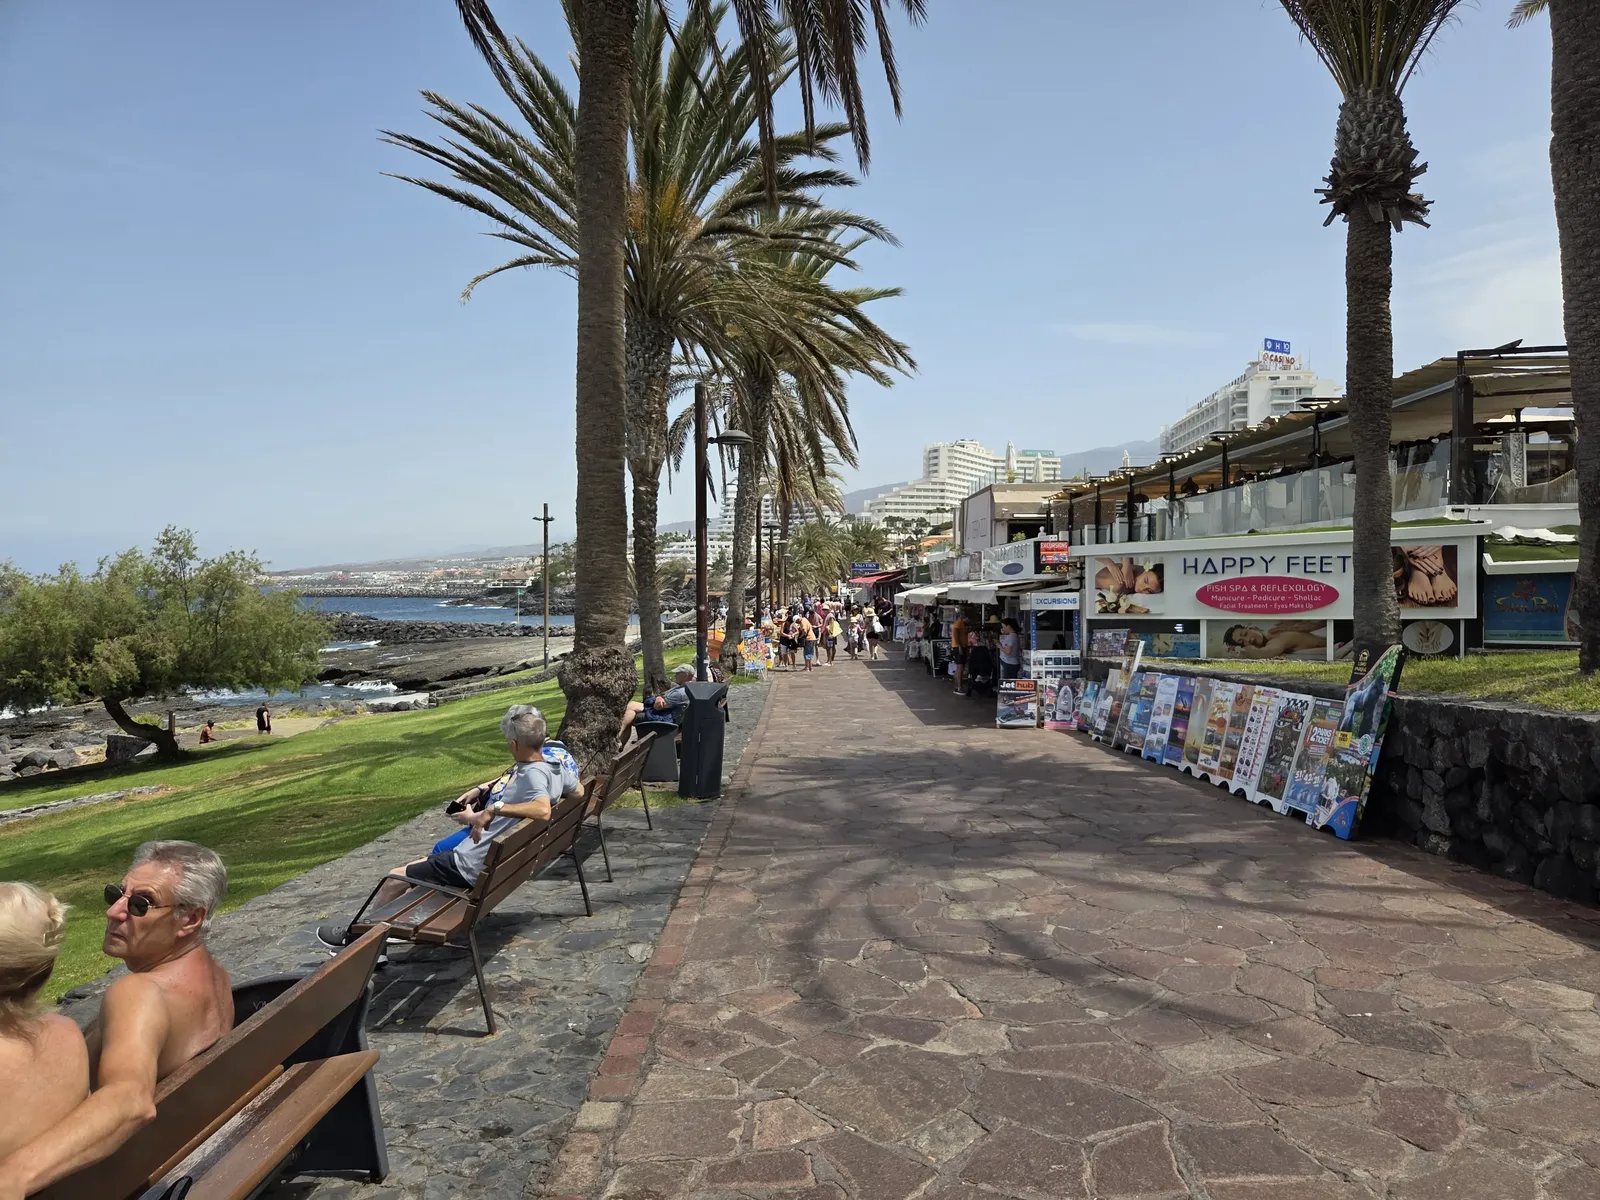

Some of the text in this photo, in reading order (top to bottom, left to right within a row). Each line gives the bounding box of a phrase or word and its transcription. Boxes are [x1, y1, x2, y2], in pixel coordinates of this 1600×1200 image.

[1183, 555, 1352, 575] HAPPY FEET
[1206, 584, 1327, 592] FISH SPA & REFLEXOLOGY
[1211, 594, 1245, 602] Manicure
[1252, 594, 1285, 602] Pedicure
[1000, 681, 1035, 689] Jet hub
